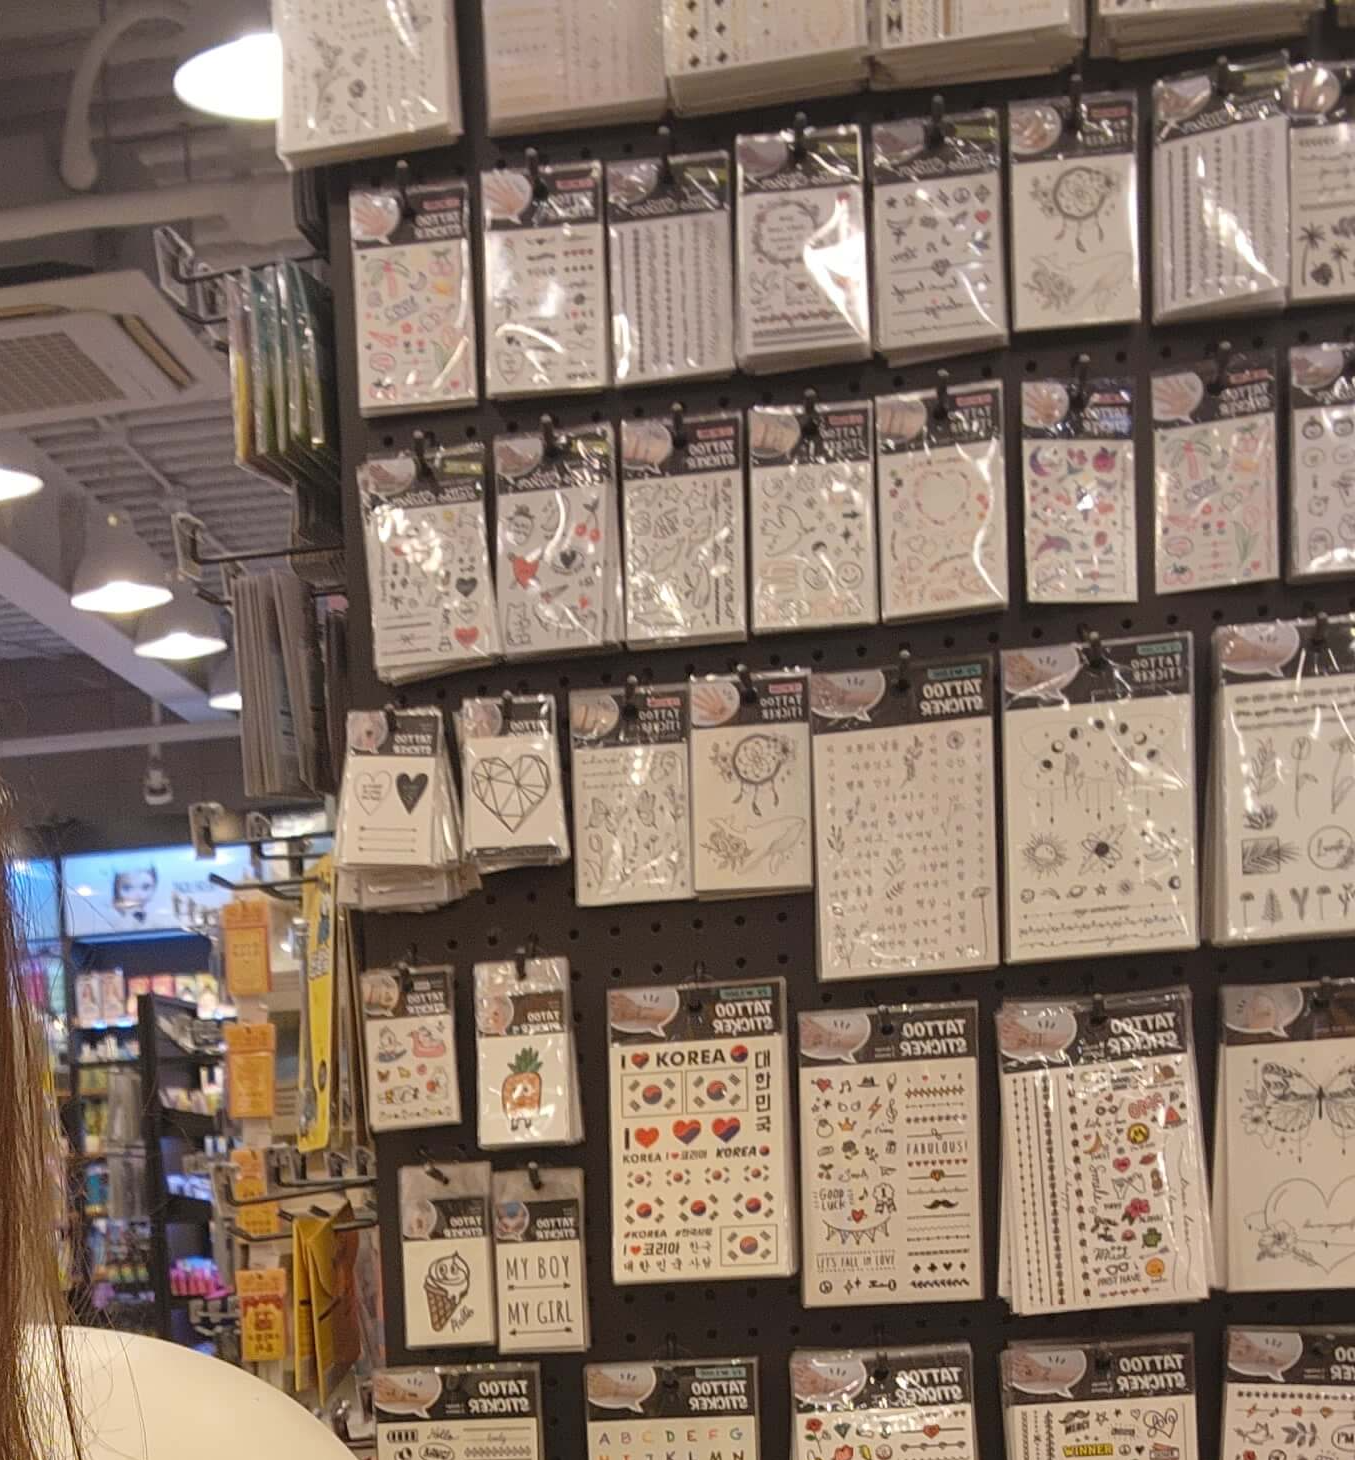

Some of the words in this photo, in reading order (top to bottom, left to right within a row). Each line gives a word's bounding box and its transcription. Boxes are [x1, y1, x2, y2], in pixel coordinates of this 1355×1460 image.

[621, 1054, 626, 1069] I
[656, 1048, 727, 1067] KOREA
[755, 1049, 771, 1133] 대한민국
[622, 1152, 662, 1164] KOREA
[715, 1146, 758, 1158] KOREA
[643, 1242, 680, 1256] 코리아
[506, 1257, 528, 1280] MY
[538, 1256, 569, 1280] BOY
[507, 1301, 529, 1325] MY
[537, 1300, 573, 1324] GIRL
[599, 1433, 610, 1445] A
[621, 1432, 631, 1444] B
[642, 1431, 653, 1444] C
[666, 1430, 675, 1442] D
[687, 1430, 697, 1442] E
[709, 1429, 718, 1440] F
[730, 1428, 743, 1440] G
[1062, 1443, 1114, 1457] WINNER
